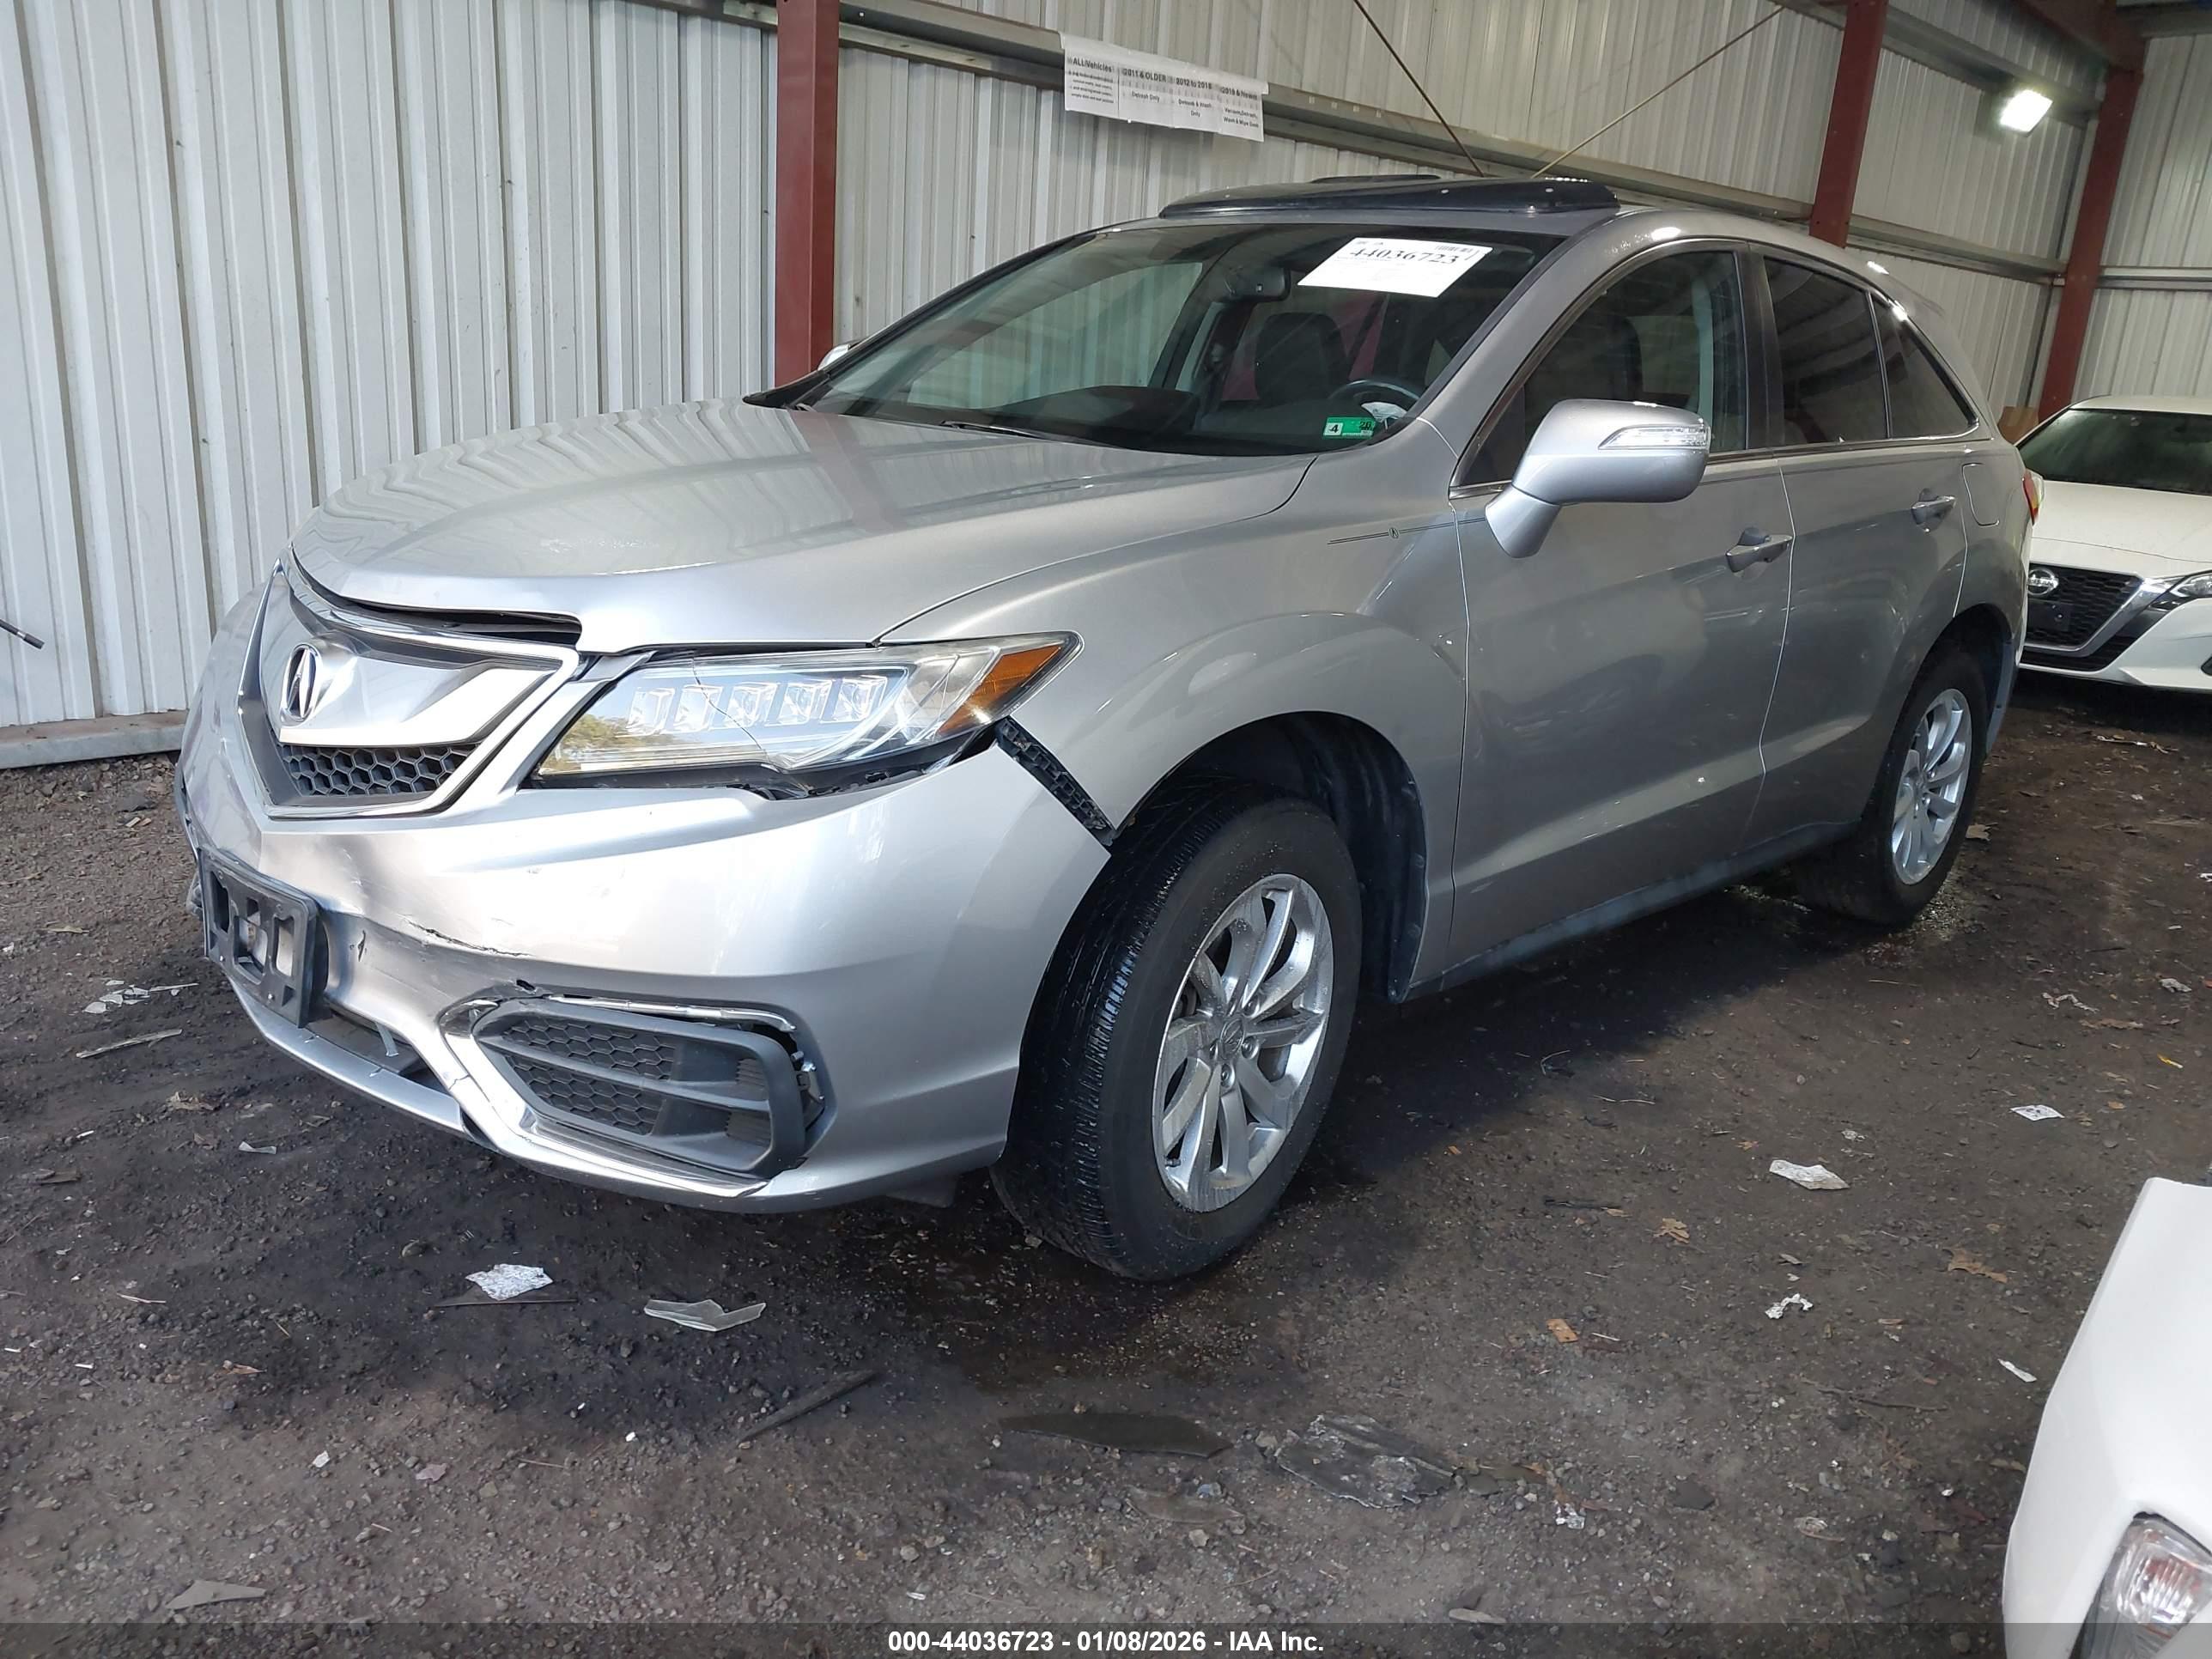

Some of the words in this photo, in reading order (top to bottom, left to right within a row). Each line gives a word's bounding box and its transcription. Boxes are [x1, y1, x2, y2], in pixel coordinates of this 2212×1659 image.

[1146, 71, 1166, 82] OLDER
[1350, 247, 1459, 264] 44036723
[1328, 424, 1339, 434] 4
